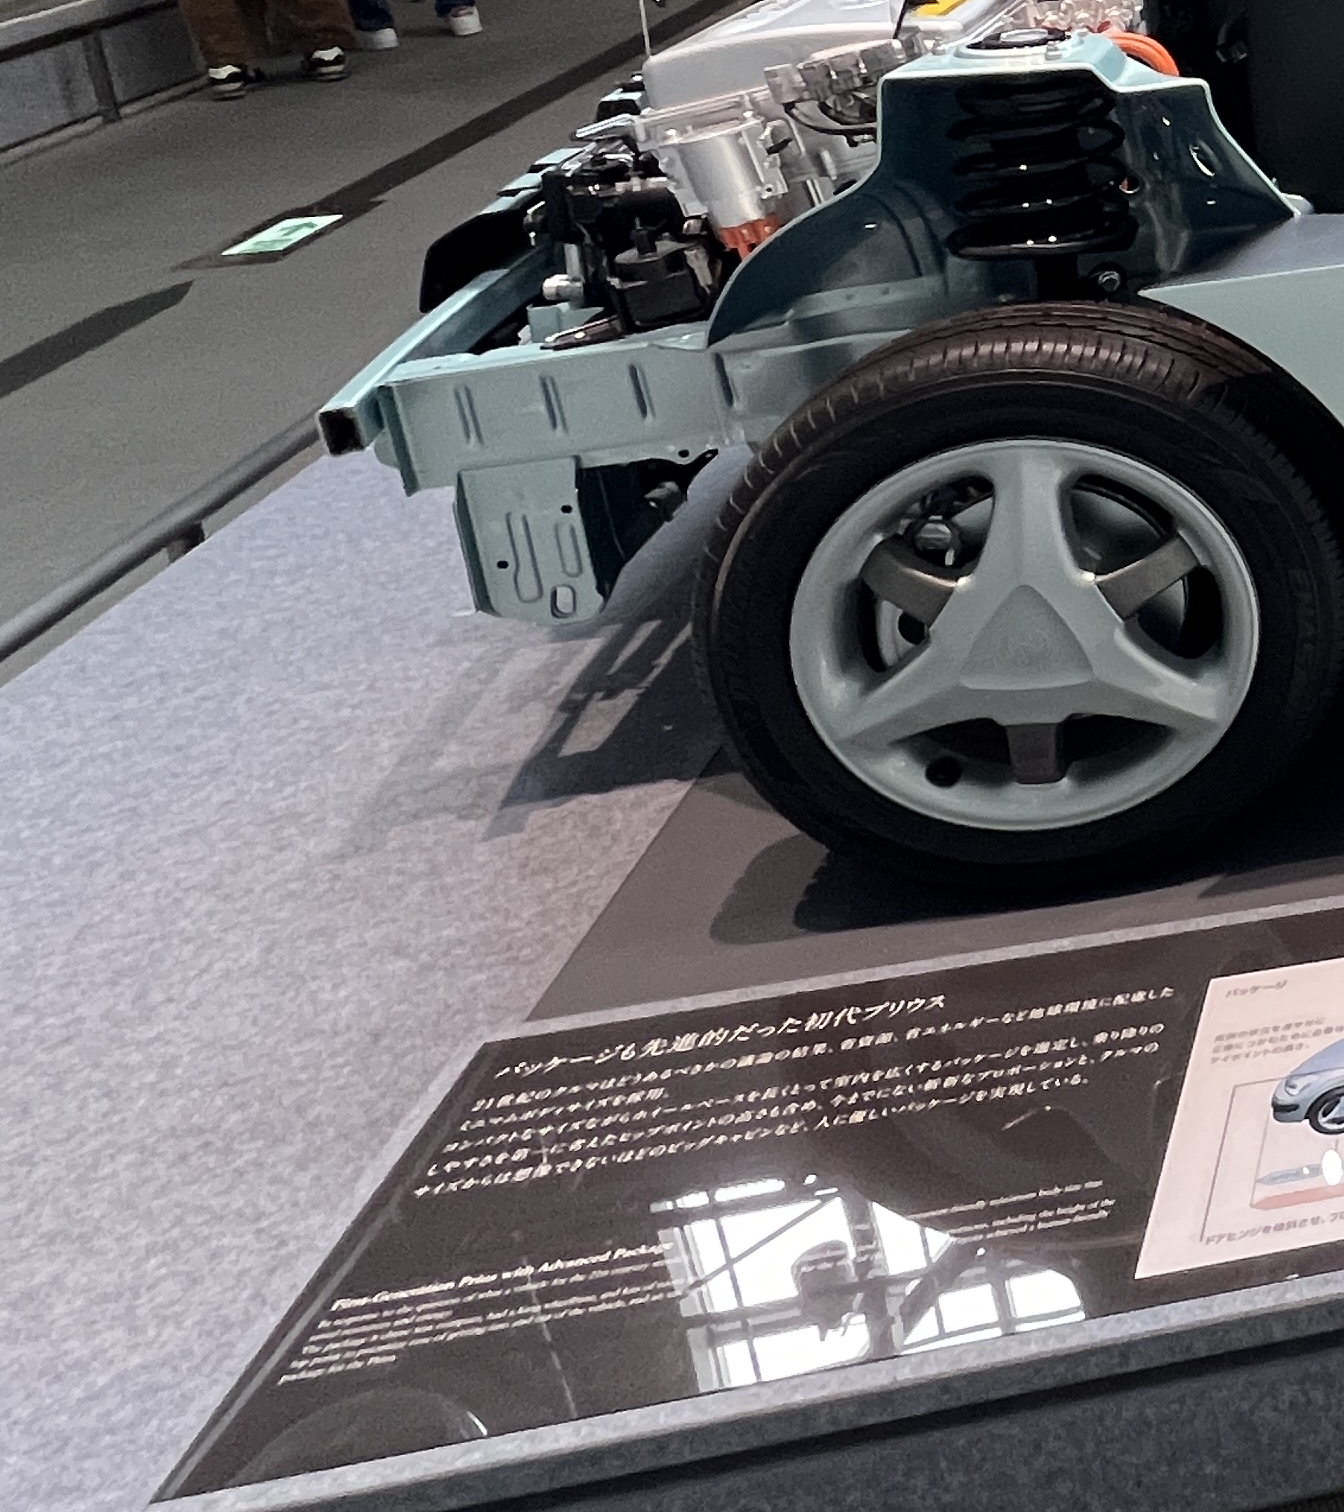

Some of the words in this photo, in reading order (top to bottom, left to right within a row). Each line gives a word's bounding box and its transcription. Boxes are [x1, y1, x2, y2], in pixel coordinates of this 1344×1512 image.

[1225, 979, 1288, 998] パッケージ
[494, 994, 947, 1078] パッケージも先進的だった初代プリウス
[538, 1250, 611, 1274] Advanced
